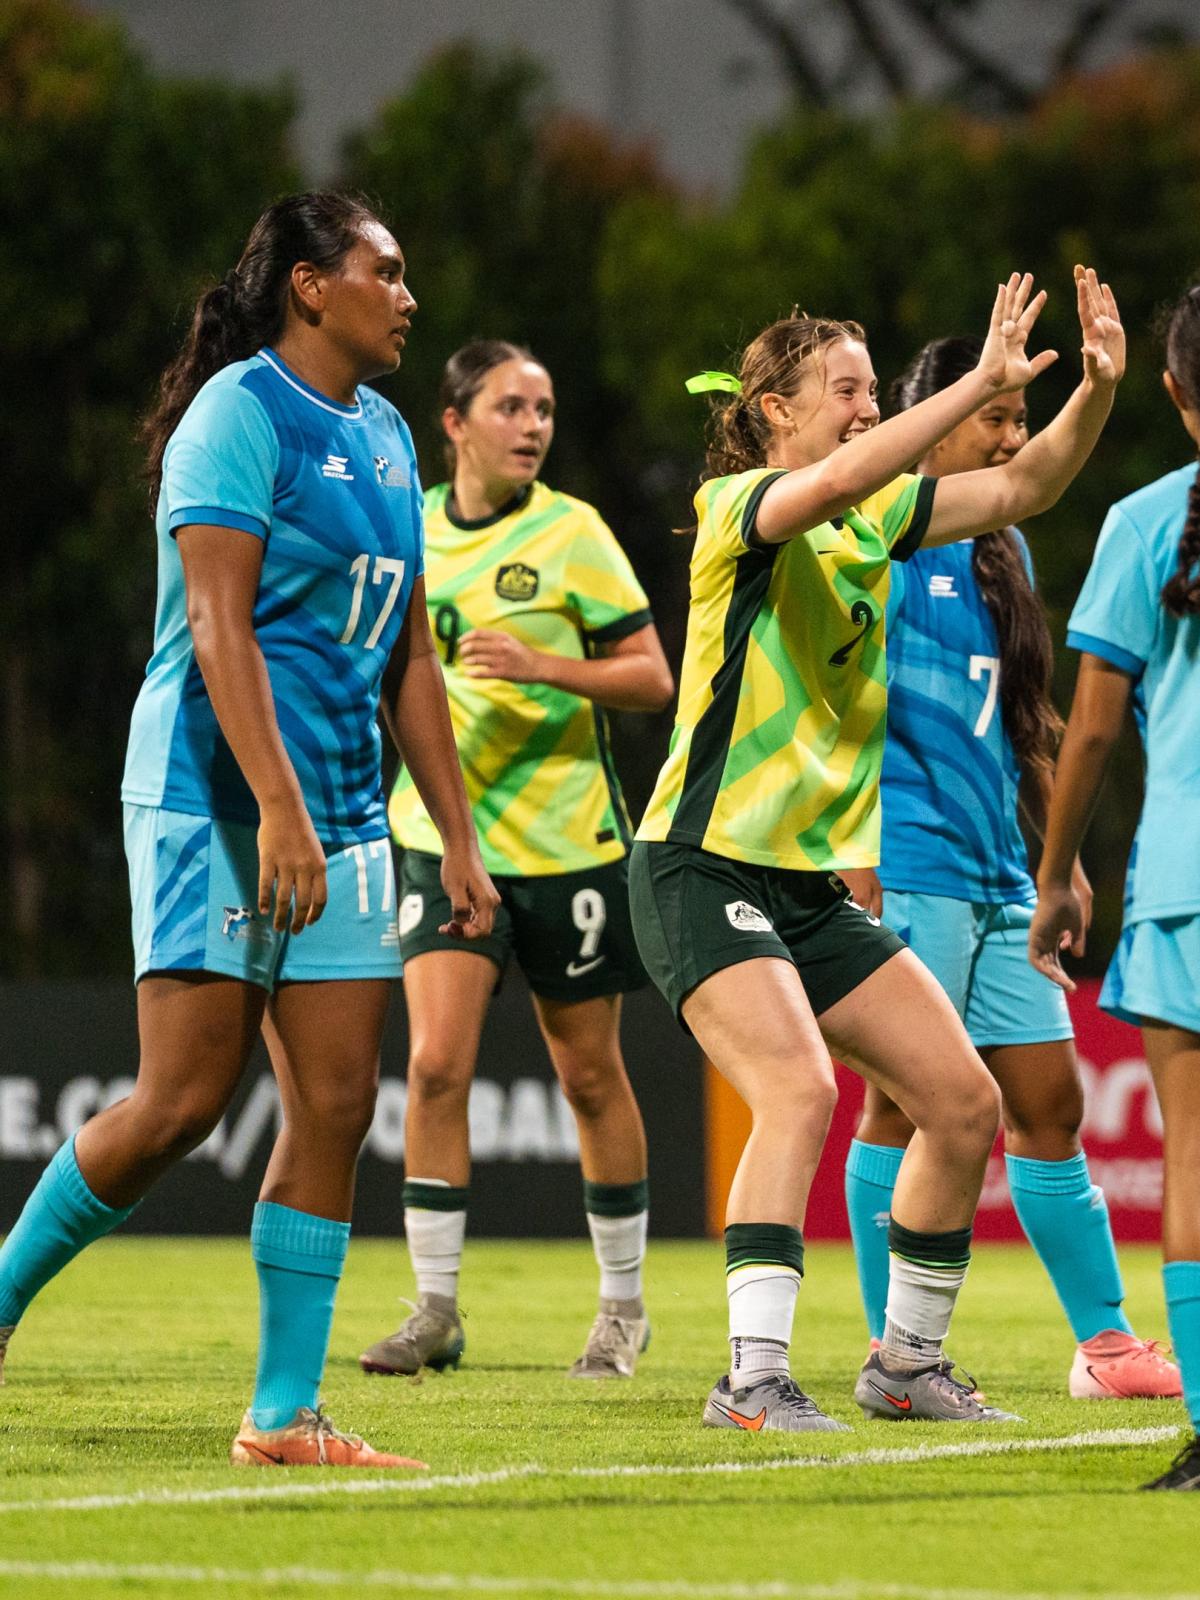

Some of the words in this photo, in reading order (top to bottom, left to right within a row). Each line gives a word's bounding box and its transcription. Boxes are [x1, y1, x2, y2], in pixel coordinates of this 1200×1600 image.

[340, 553, 405, 650] 17
[435, 604, 460, 666] 9
[828, 600, 874, 669] 2
[969, 655, 1000, 737] 7
[344, 837, 394, 913] 17
[572, 888, 606, 958] 9
